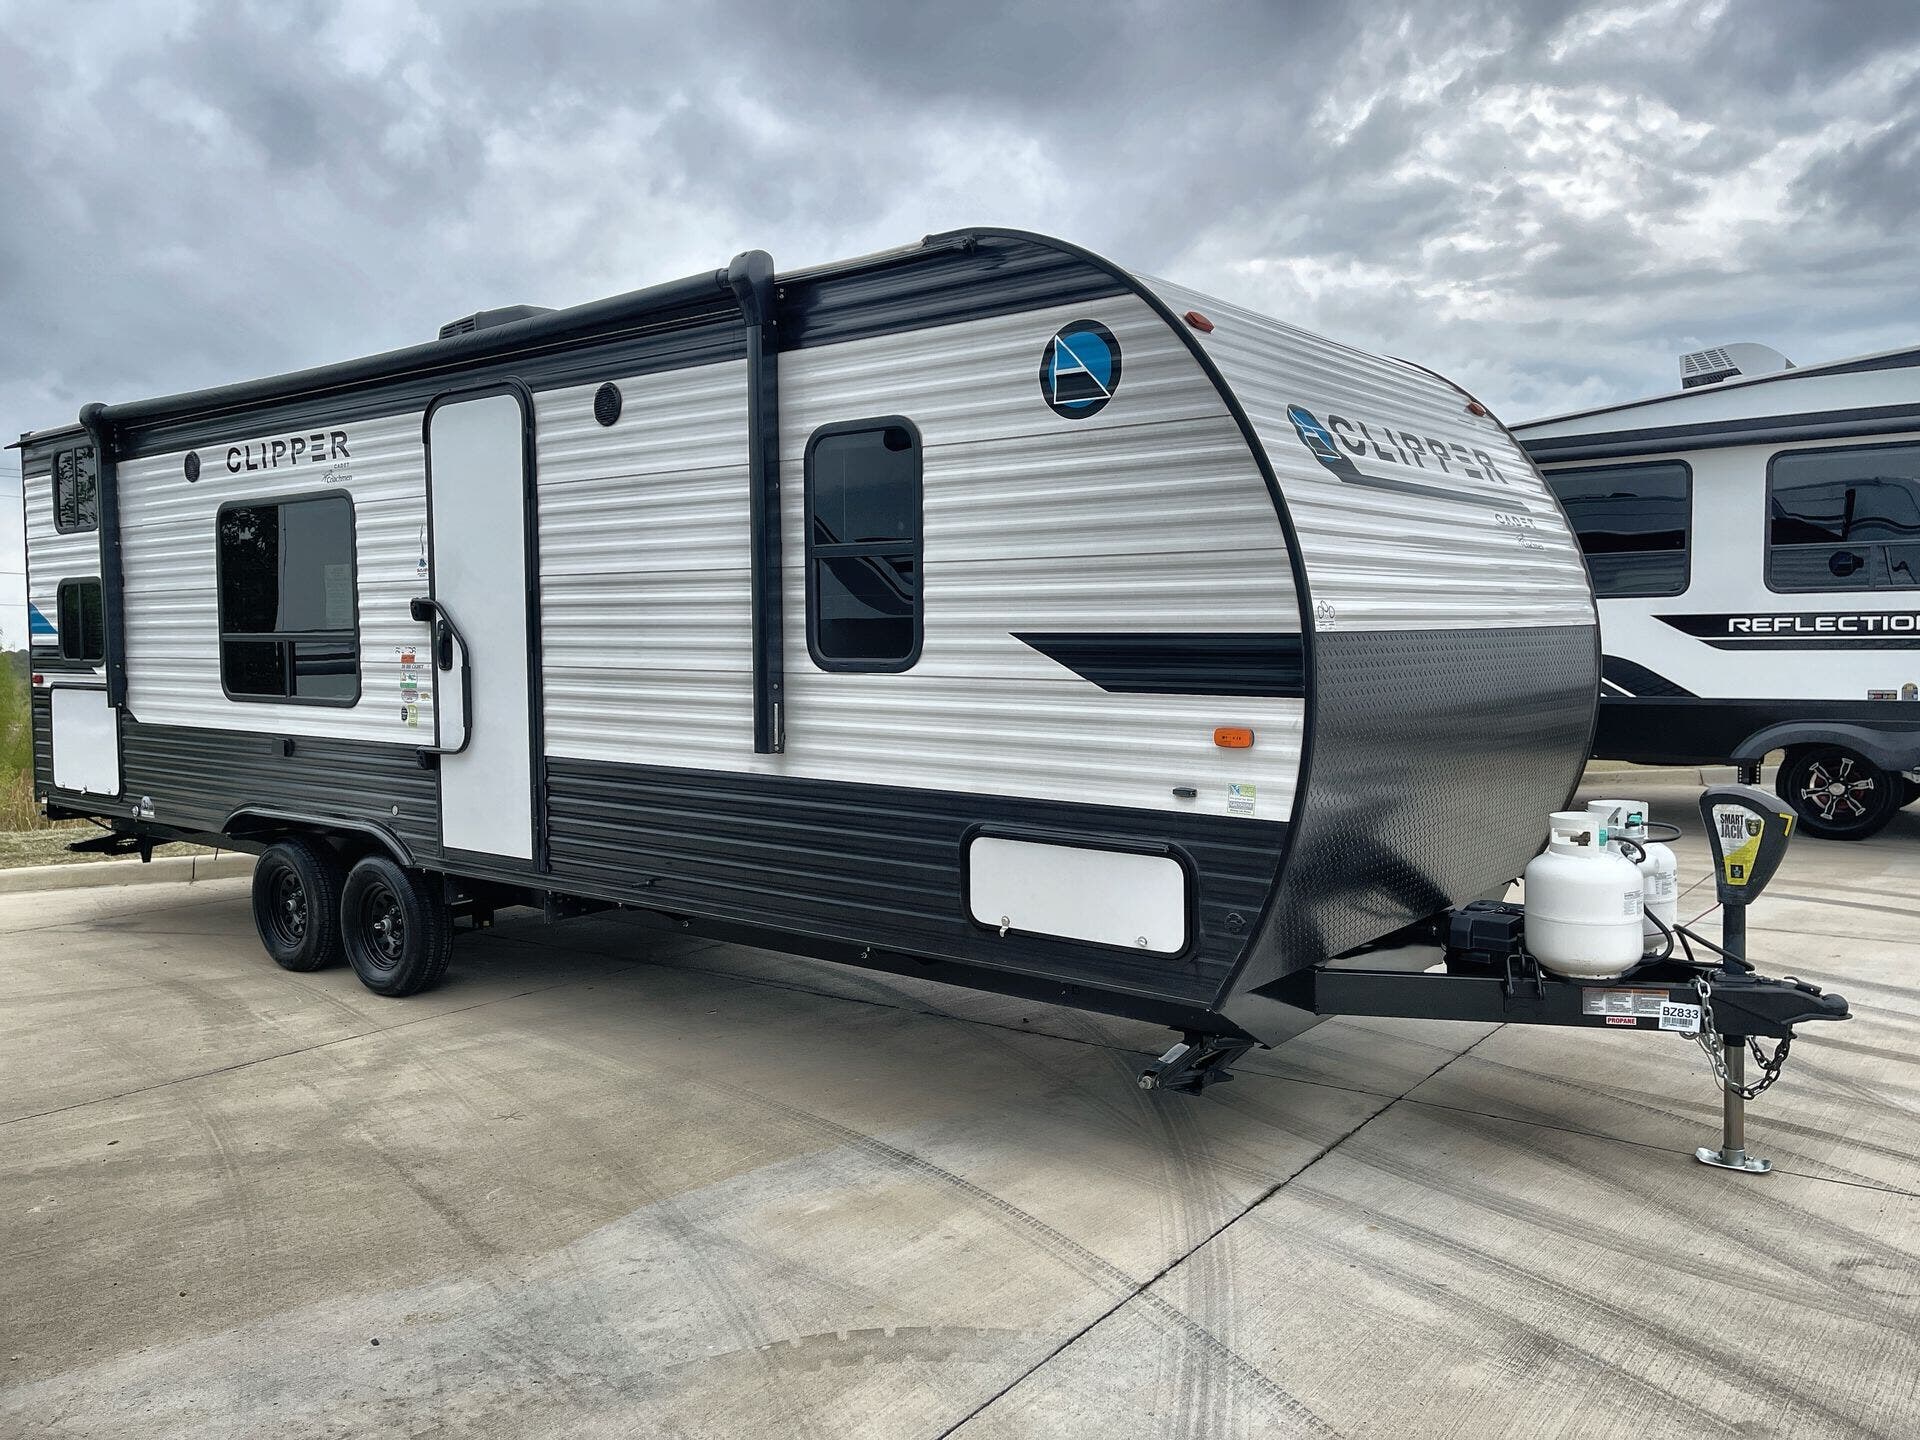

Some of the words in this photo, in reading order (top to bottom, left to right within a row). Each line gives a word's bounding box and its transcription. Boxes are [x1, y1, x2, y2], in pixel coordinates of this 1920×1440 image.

[226, 430, 351, 473] CLIPPER
[1328, 414, 1509, 485] CLIPPER
[1494, 513, 1537, 529] CADET
[1728, 615, 1920, 633] REFLECTIO
[1720, 813, 1744, 825] SMART
[1720, 825, 1743, 839] JACK
[1662, 1006, 1699, 1019] BZ833
[1607, 1017, 1636, 1025] PROPANE
